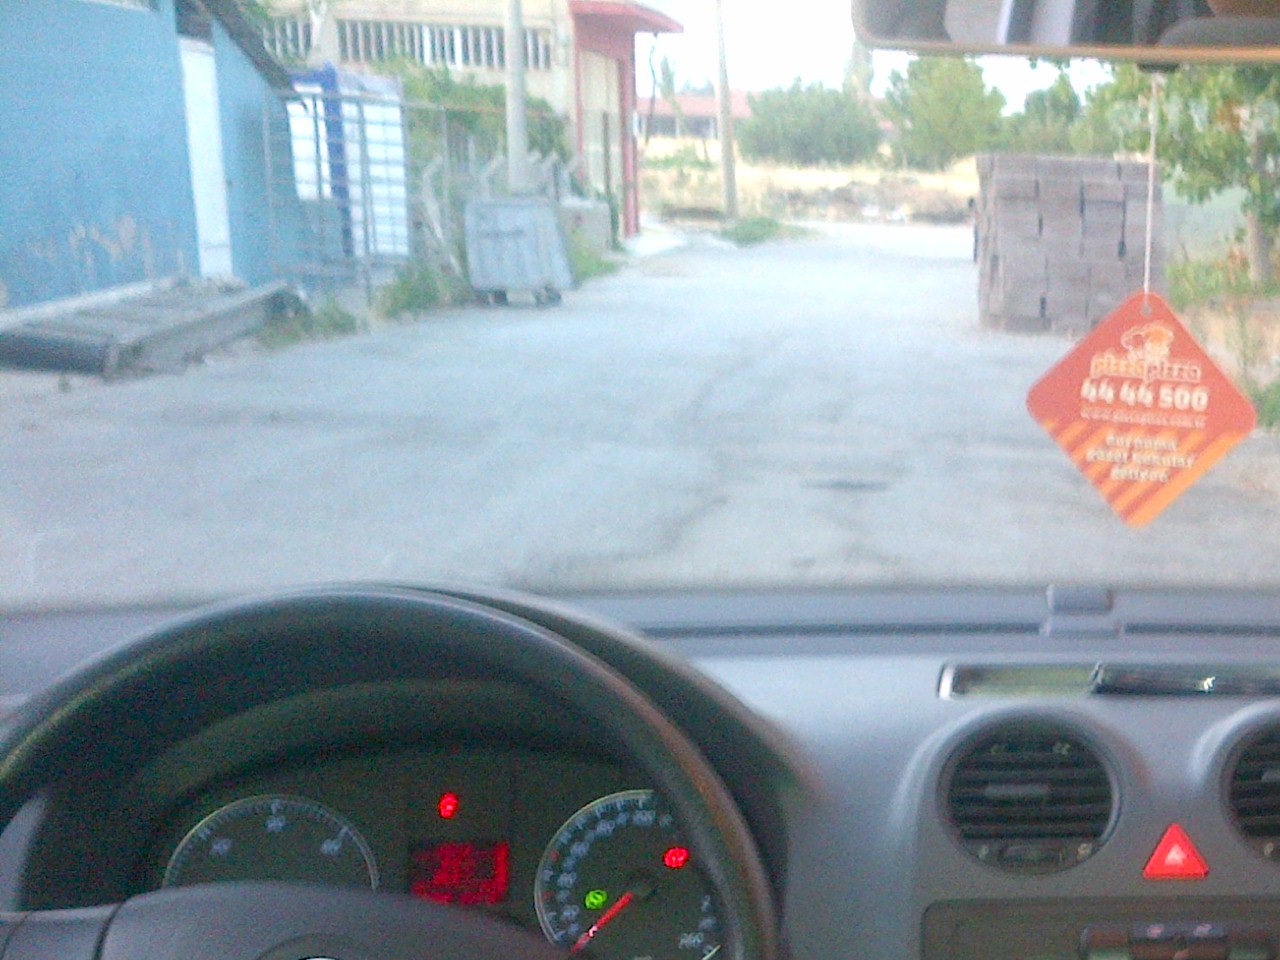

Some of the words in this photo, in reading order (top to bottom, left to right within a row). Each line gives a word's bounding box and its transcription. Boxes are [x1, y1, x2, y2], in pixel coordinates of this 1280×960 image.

[1080, 378, 1115, 404] 44
[1119, 381, 1154, 408] 44
[1158, 384, 1208, 412] 500
